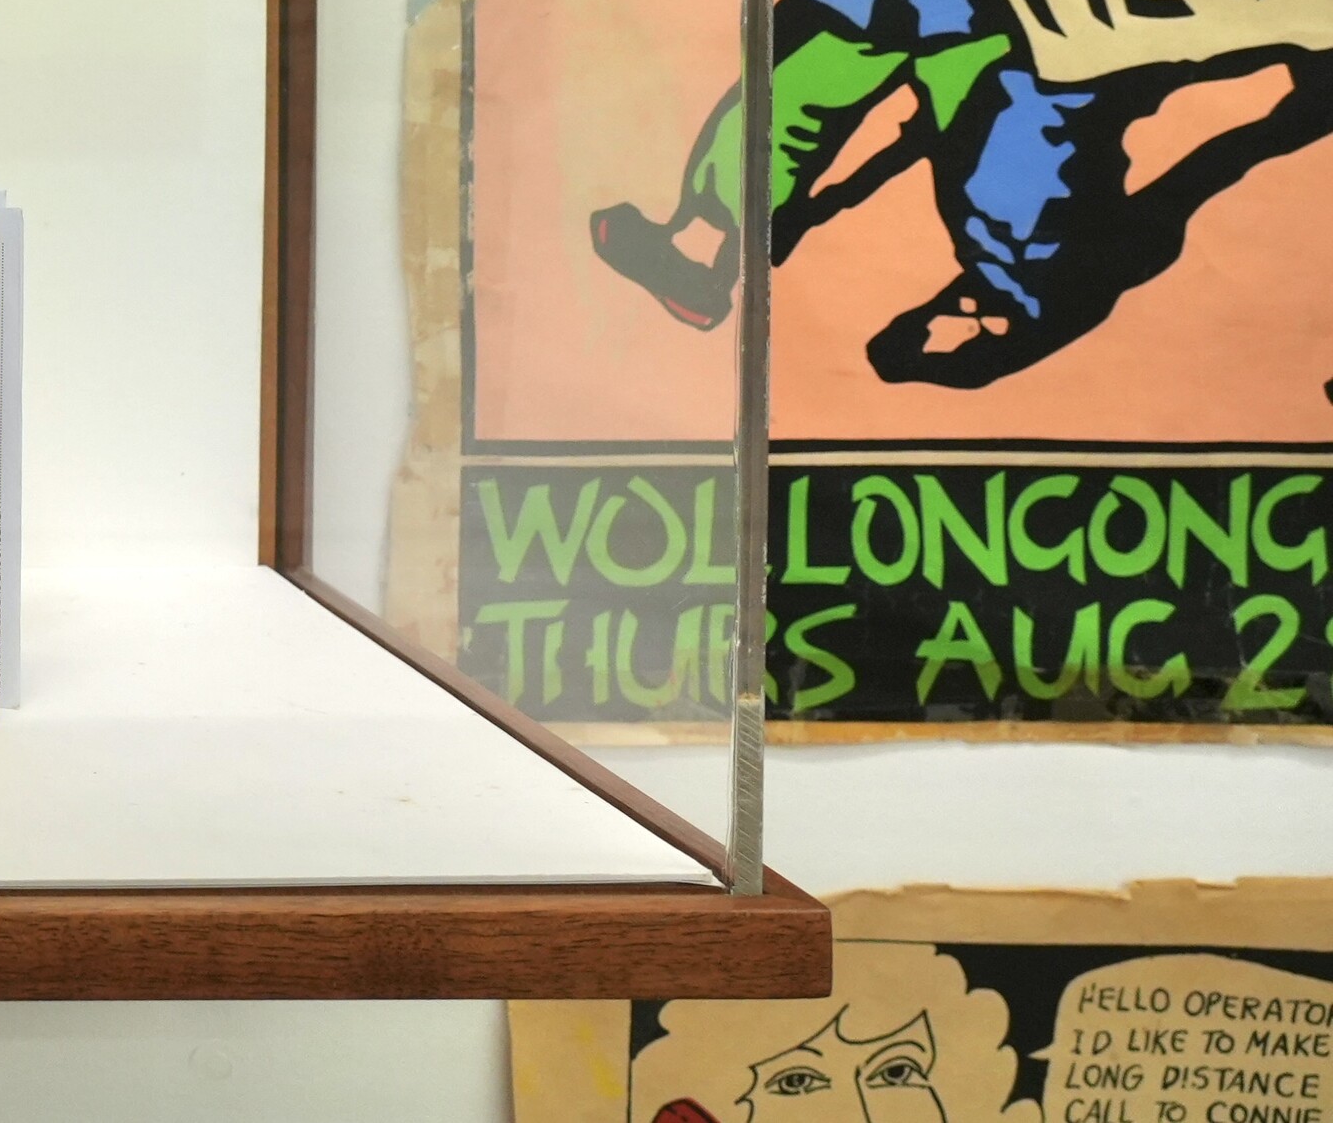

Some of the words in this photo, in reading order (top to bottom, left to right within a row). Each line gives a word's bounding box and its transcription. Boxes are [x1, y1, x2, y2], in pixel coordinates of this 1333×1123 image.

[477, 471, 1333, 590] WOLLONGONG
[916, 597, 1190, 709] AUG
[1220, 594, 1333, 712] 2
[1078, 981, 1170, 1014] HELLO
[1127, 1028, 1188, 1055] LIKE
[1202, 1030, 1235, 1054] TO
[1245, 1030, 1330, 1057] MAKE
[1065, 1063, 1144, 1091] LONG
[1161, 1065, 1320, 1099] DISTANCE
[1065, 1099, 1132, 1123] CALL
[1156, 1101, 1187, 1123] TO
